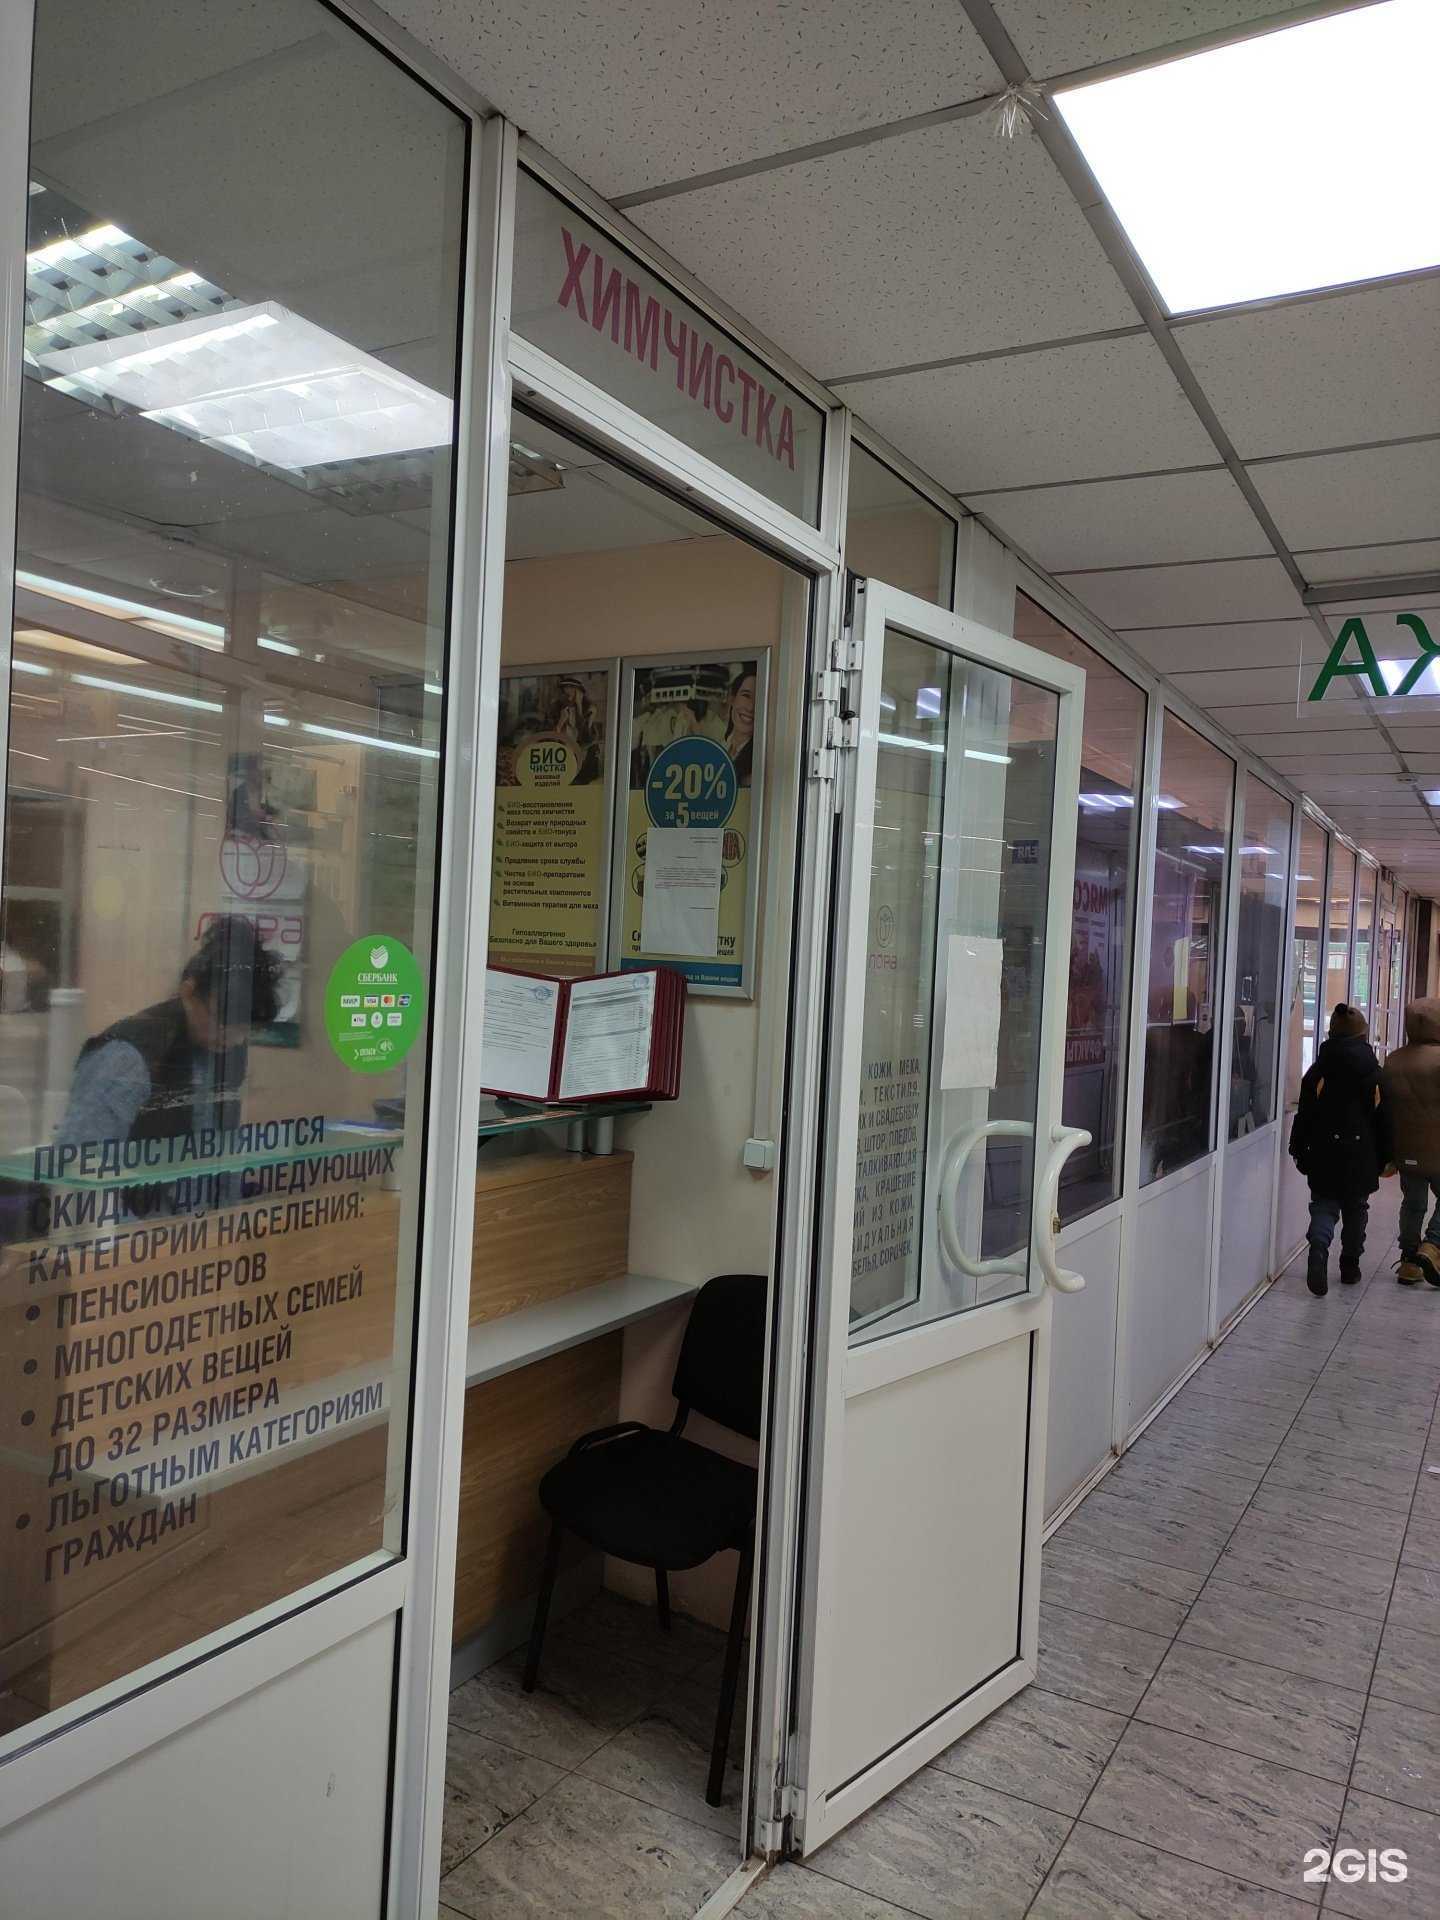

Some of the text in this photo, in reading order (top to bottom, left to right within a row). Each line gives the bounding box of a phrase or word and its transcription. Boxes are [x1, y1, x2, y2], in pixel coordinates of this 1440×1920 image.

[558, 226, 795, 472] ХИМЧИСТКА
[530, 747, 567, 765] БИО
[652, 763, 727, 800] -20%
[665, 801, 719, 828] за 5 вещей
[357, 972, 398, 983] СБЕРБАНК
[33, 1116, 326, 1181] ПРЕДОСТАВЛЯЮТСЯ
[240, 1146, 396, 1200] СЛЕДУЮЩИХ
[872, 1203, 883, 1222] ИЗ
[875, 1171, 916, 1198] КРАШЕНИЕ
[28, 1192, 366, 1284] КАТЕГОРИЙ НАСЕЛЕНИЯ:
[54, 1265, 363, 1380] МНОГОДЕТНЫХ СЕМЕЙ
[56, 1252, 267, 1329] ПЕНСИОНЕРОВ
[50, 1326, 293, 1438] ДЕТСКИХ ВЕЩЕЙ
[45, 1382, 384, 1533] ЛЬГОТНЫМ КАТЕГОРИЯМ
[48, 1376, 280, 1488] ДО 32 РАЗМЕРА
[44, 1498, 197, 1584] ГРАЖДАН
